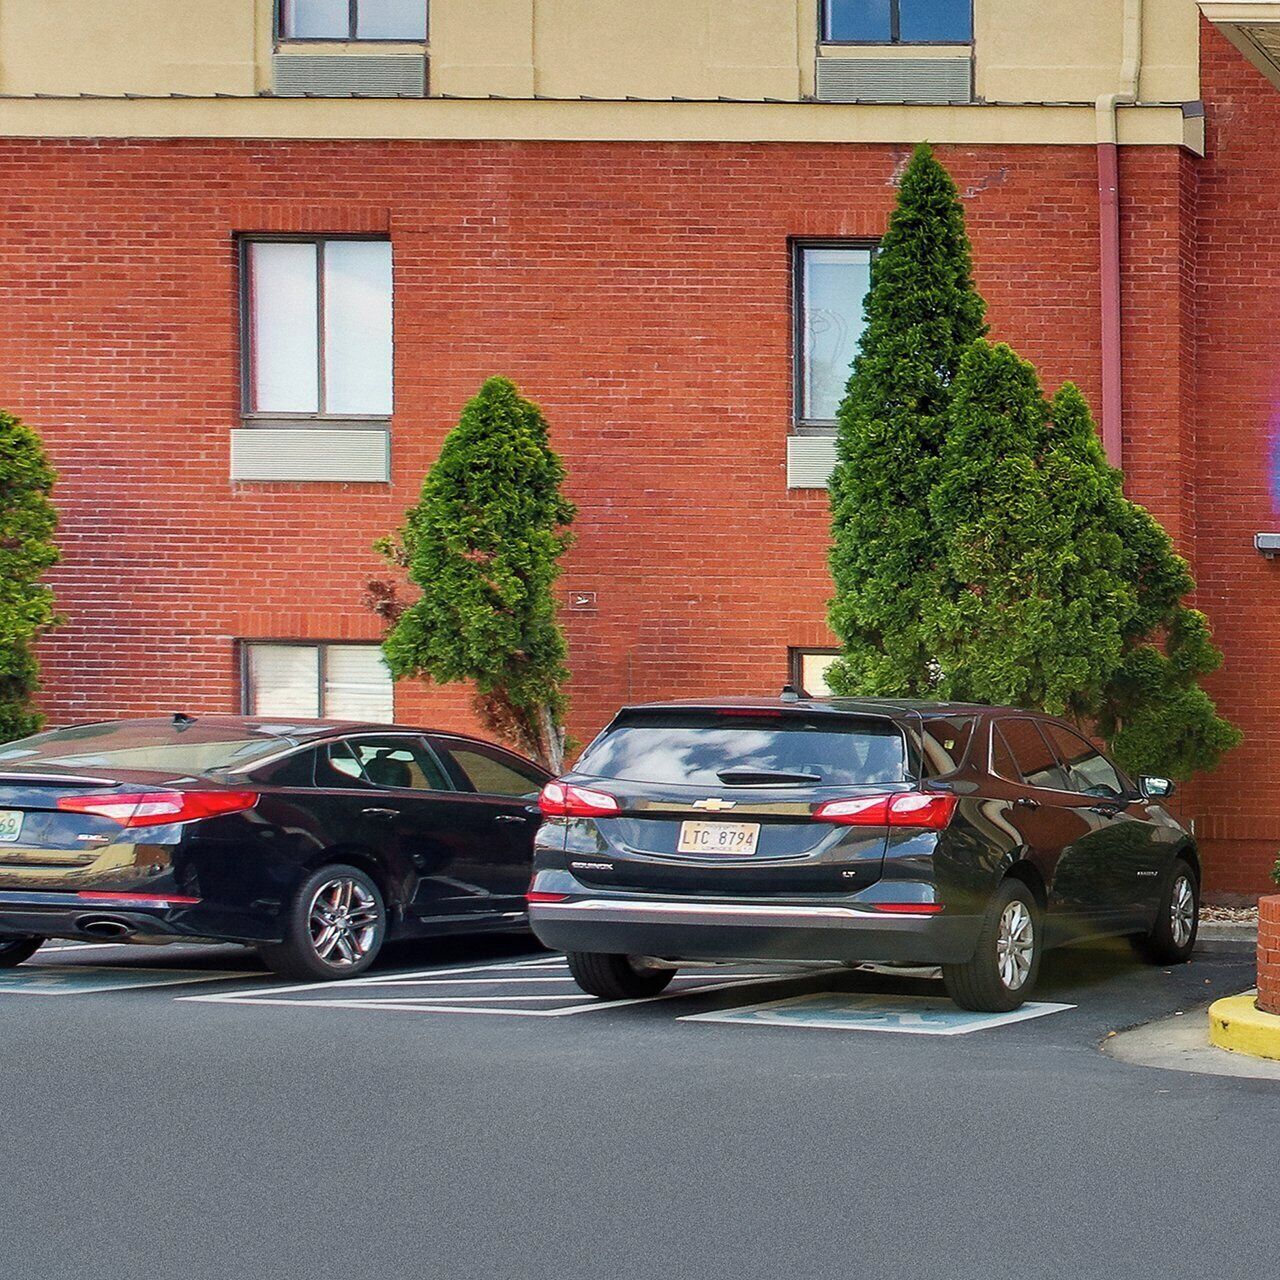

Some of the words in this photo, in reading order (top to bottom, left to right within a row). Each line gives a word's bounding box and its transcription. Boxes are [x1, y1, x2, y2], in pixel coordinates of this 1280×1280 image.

[682, 829, 710, 845] LTC
[718, 831, 755, 847] 8794
[571, 861, 614, 870] EQUINOX
